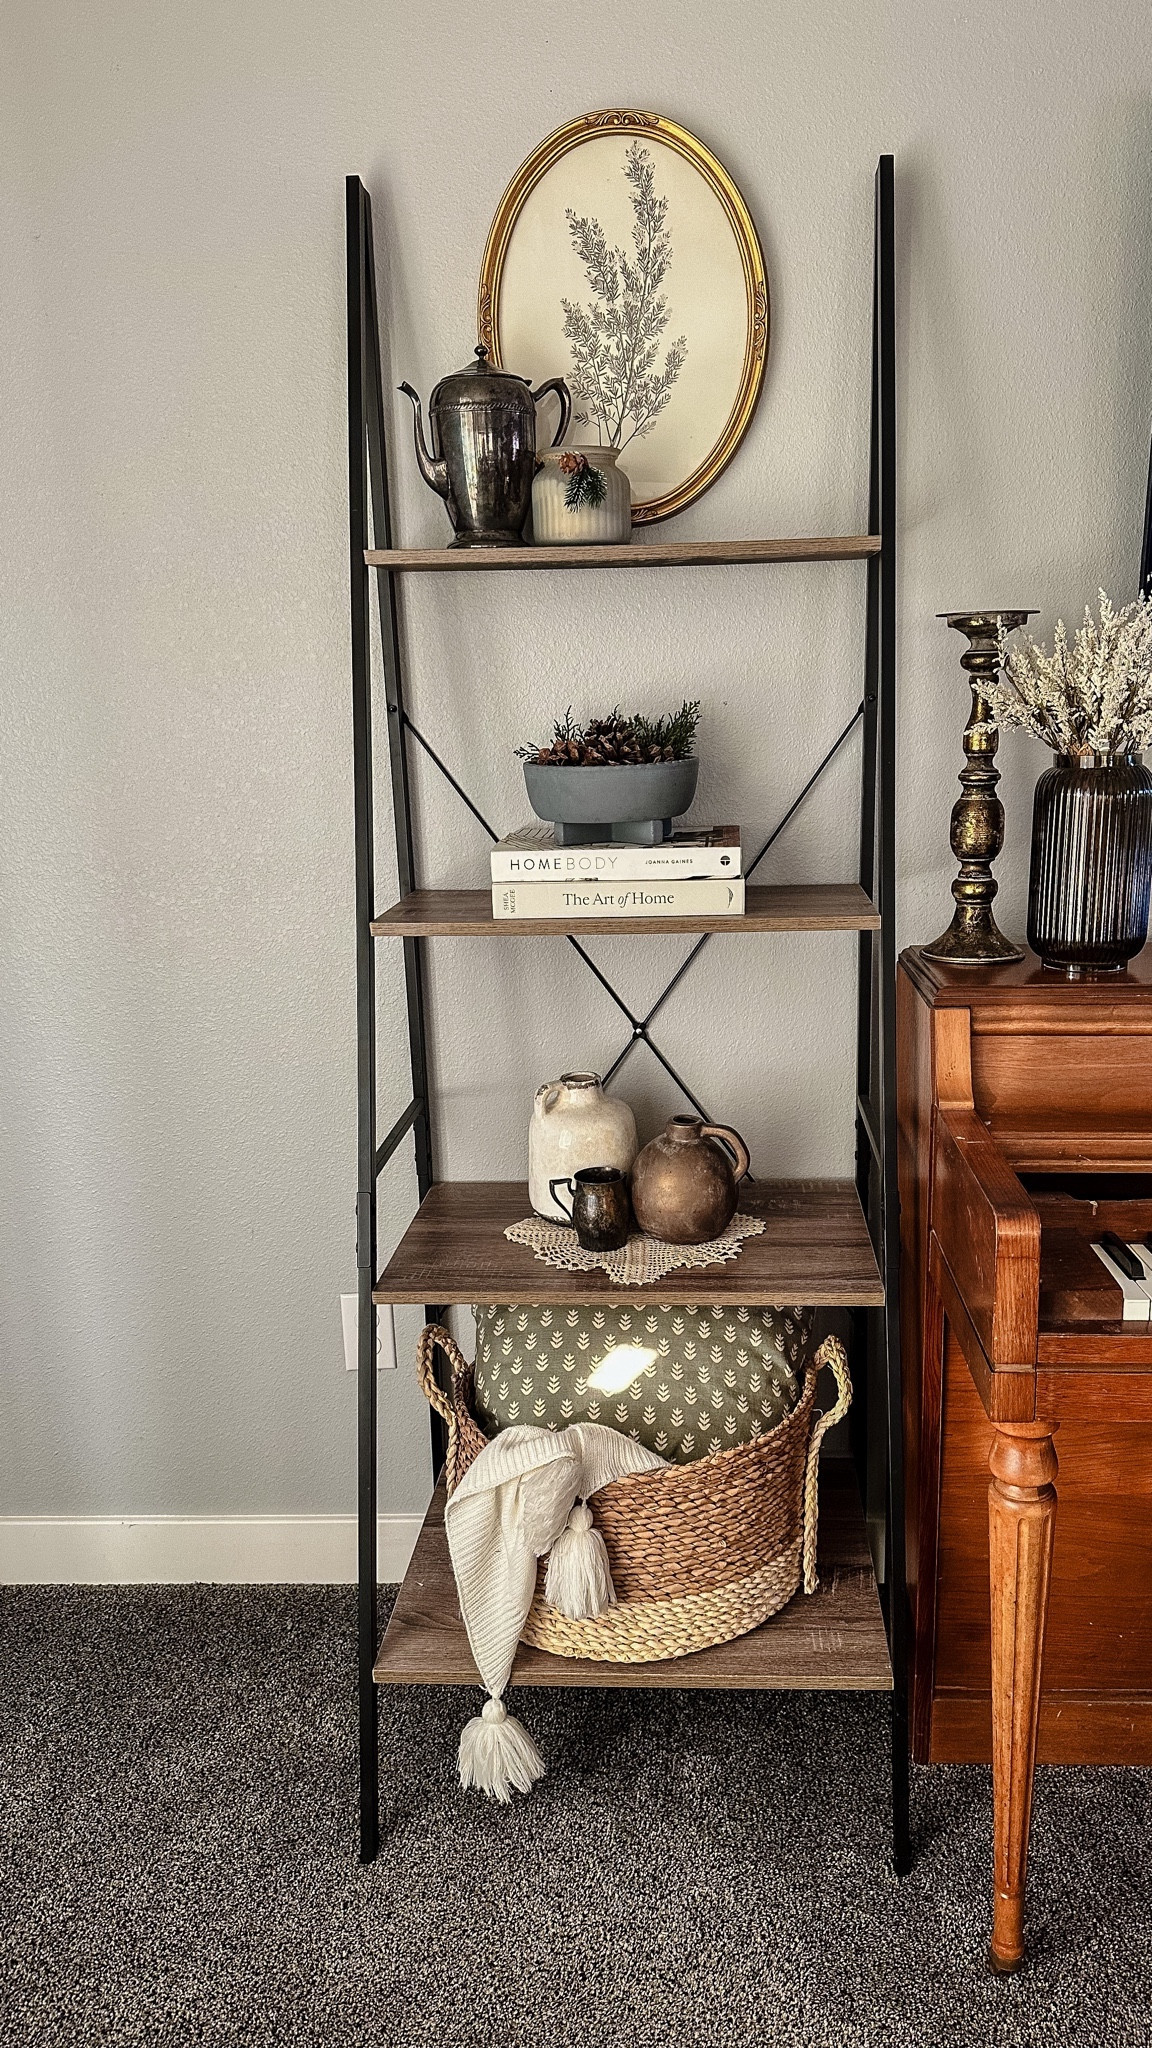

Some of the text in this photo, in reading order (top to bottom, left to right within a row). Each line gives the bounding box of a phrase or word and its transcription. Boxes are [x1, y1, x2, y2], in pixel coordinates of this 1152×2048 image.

[510, 857, 618, 871] HOMEBODY
[562, 892, 675, 909] The Art of Home
